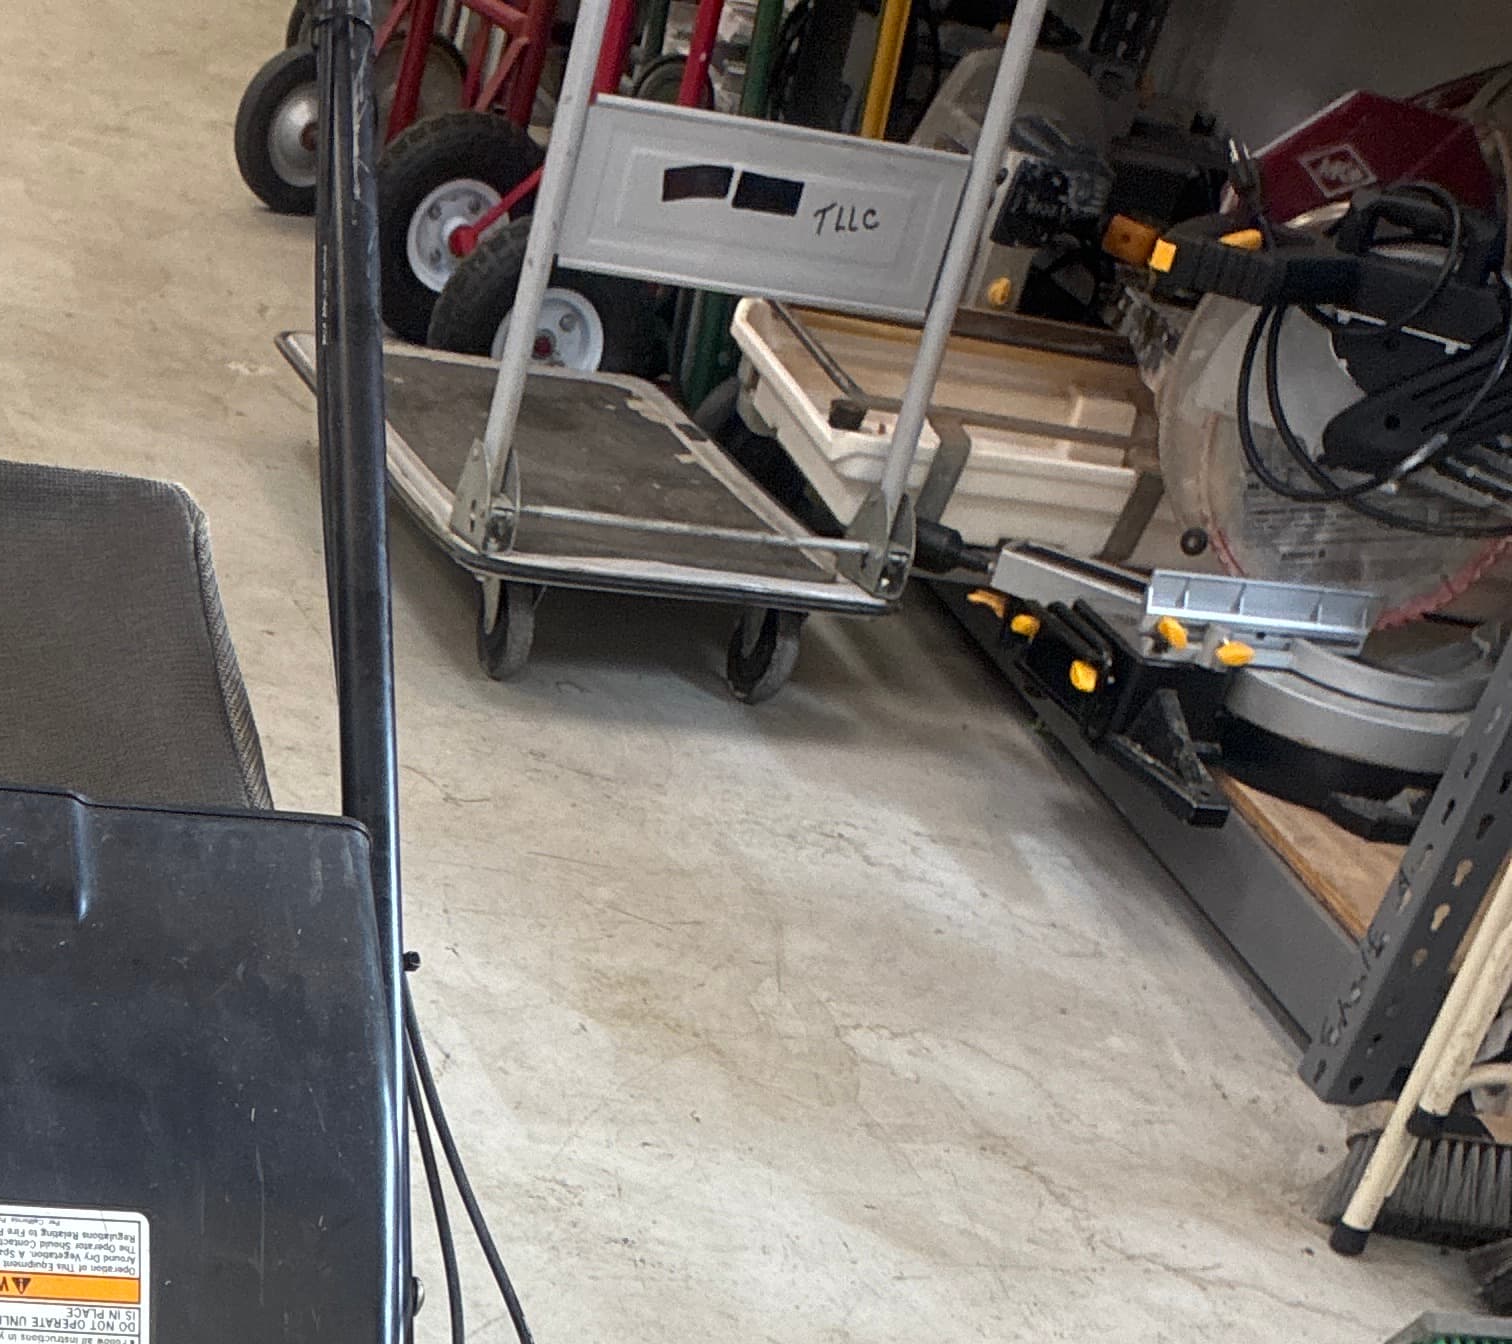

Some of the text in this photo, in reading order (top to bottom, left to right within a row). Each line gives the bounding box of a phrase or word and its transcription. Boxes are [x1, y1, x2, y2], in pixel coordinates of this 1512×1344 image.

[813, 202, 880, 236] TLLC
[8, 1228, 26, 1237] Fire
[29, 1229, 38, 1238] to
[41, 1229, 79, 1240] Relating
[83, 1231, 136, 1243] Regulations
[0, 1239, 36, 1248] Contact
[40, 1241, 71, 1250] Should
[76, 1242, 115, 1253] Operator
[19, 1250, 26, 1259] A
[120, 1246, 136, 1254] The
[85, 1253, 100, 1263] Dry
[104, 1255, 136, 1265] Around
[4, 1259, 53, 1271] Equipment
[58, 1263, 75, 1273] This
[79, 1265, 87, 1273] of
[91, 1264, 135, 1276] Operation
[67, 1308, 135, 1321] IS IN PLACE
[32, 1317, 85, 1330] OPERATE
[90, 1320, 114, 1332] NOT
[120, 1322, 135, 1333] DO
[9, 1334, 17, 1342] in
